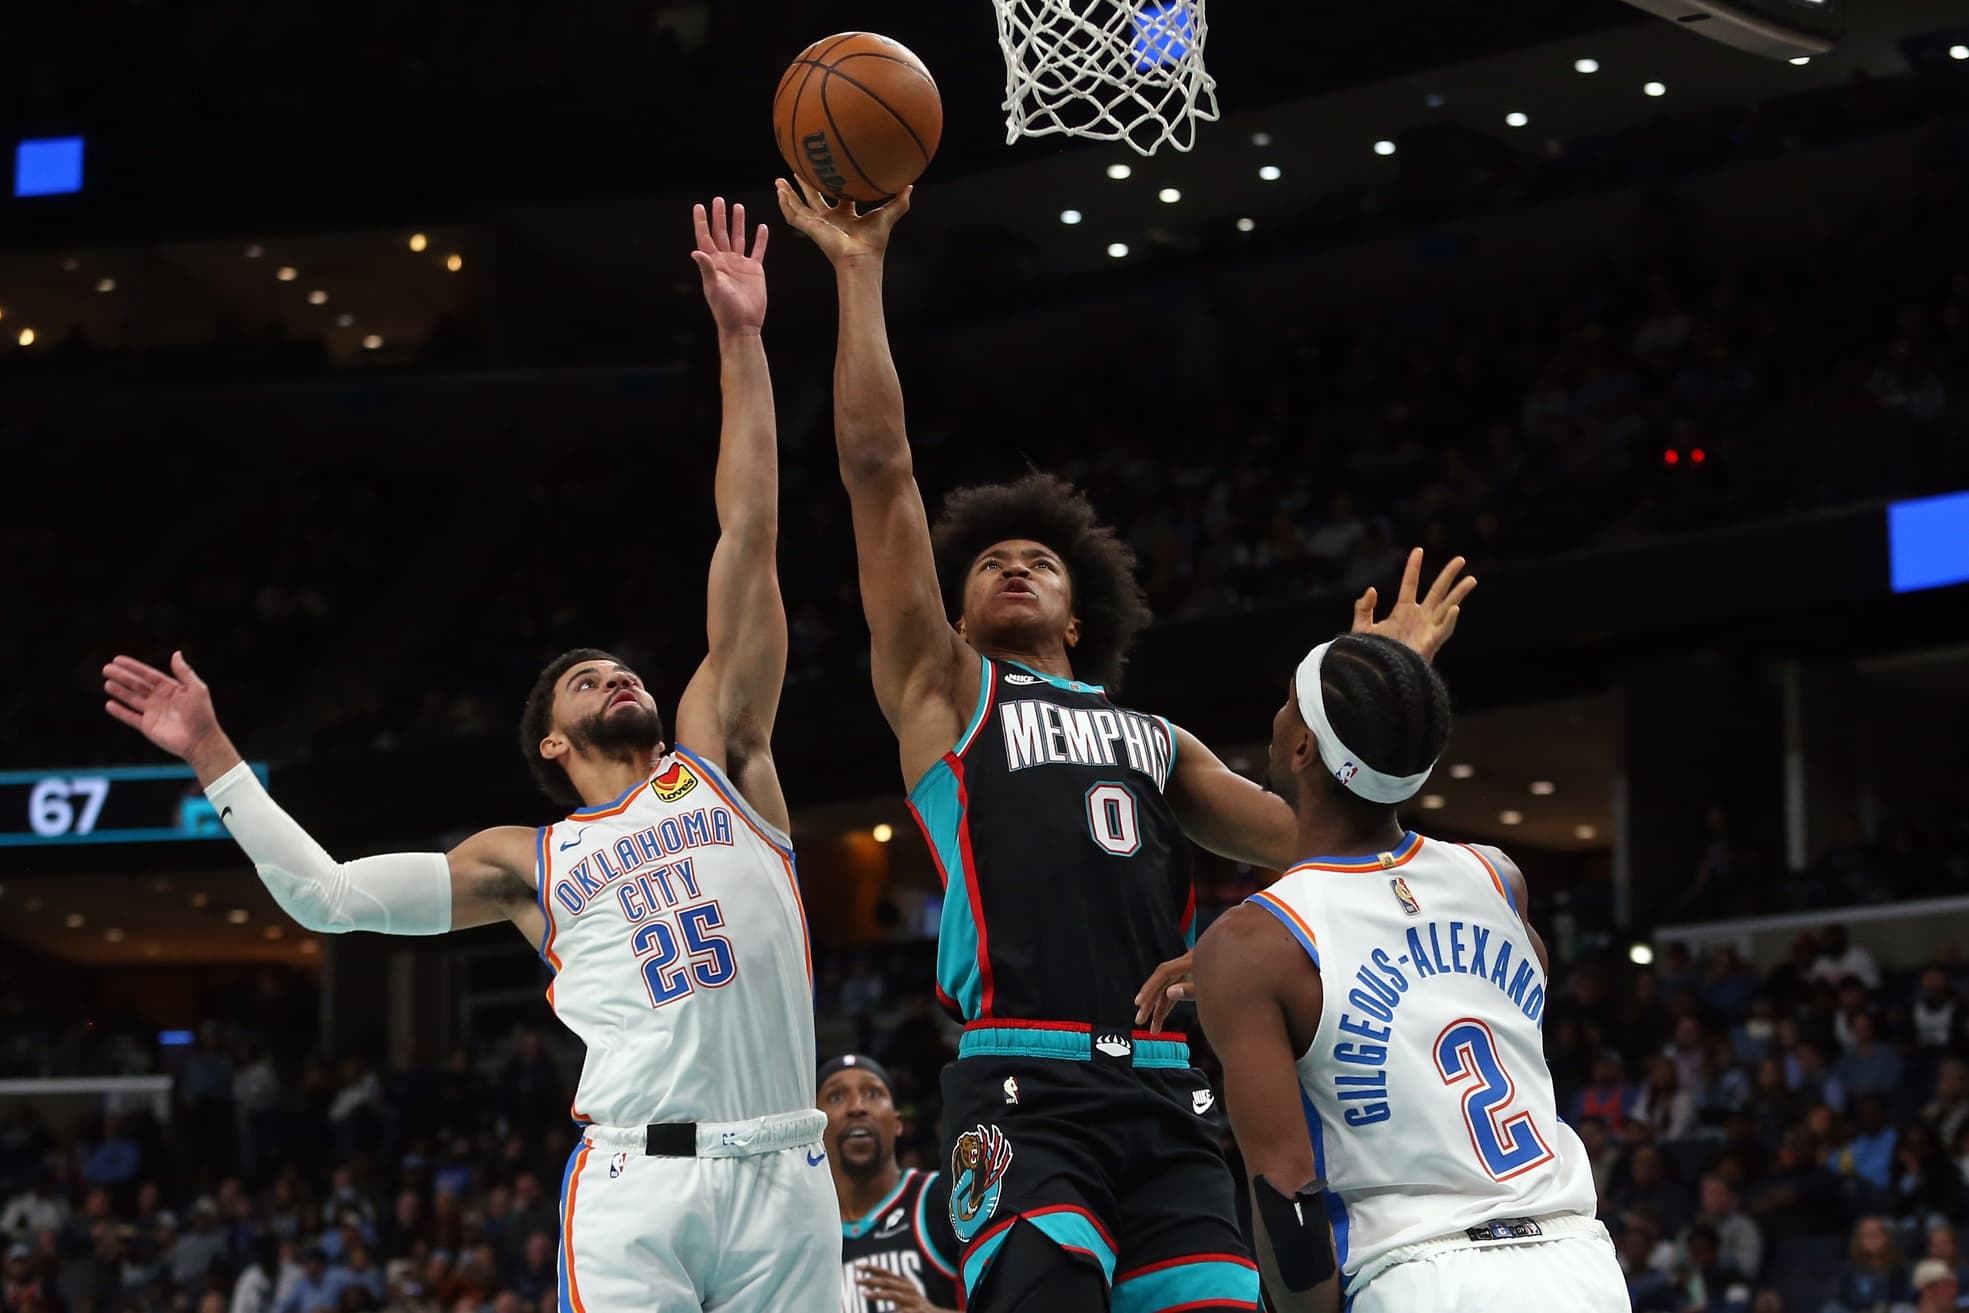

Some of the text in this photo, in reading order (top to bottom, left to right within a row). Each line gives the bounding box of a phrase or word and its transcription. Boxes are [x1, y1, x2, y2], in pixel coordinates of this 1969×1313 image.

[29, 777, 110, 837] 67
[1085, 780, 1142, 857] 0
[555, 807, 734, 916] OKLAHOMA
[616, 857, 701, 922] CITY
[631, 900, 738, 1008] 25
[1334, 921, 1544, 1128] GILGEOUS-ALEXAND
[1192, 1089, 1210, 1105] NIKE
[1432, 1017, 1555, 1183] 2
